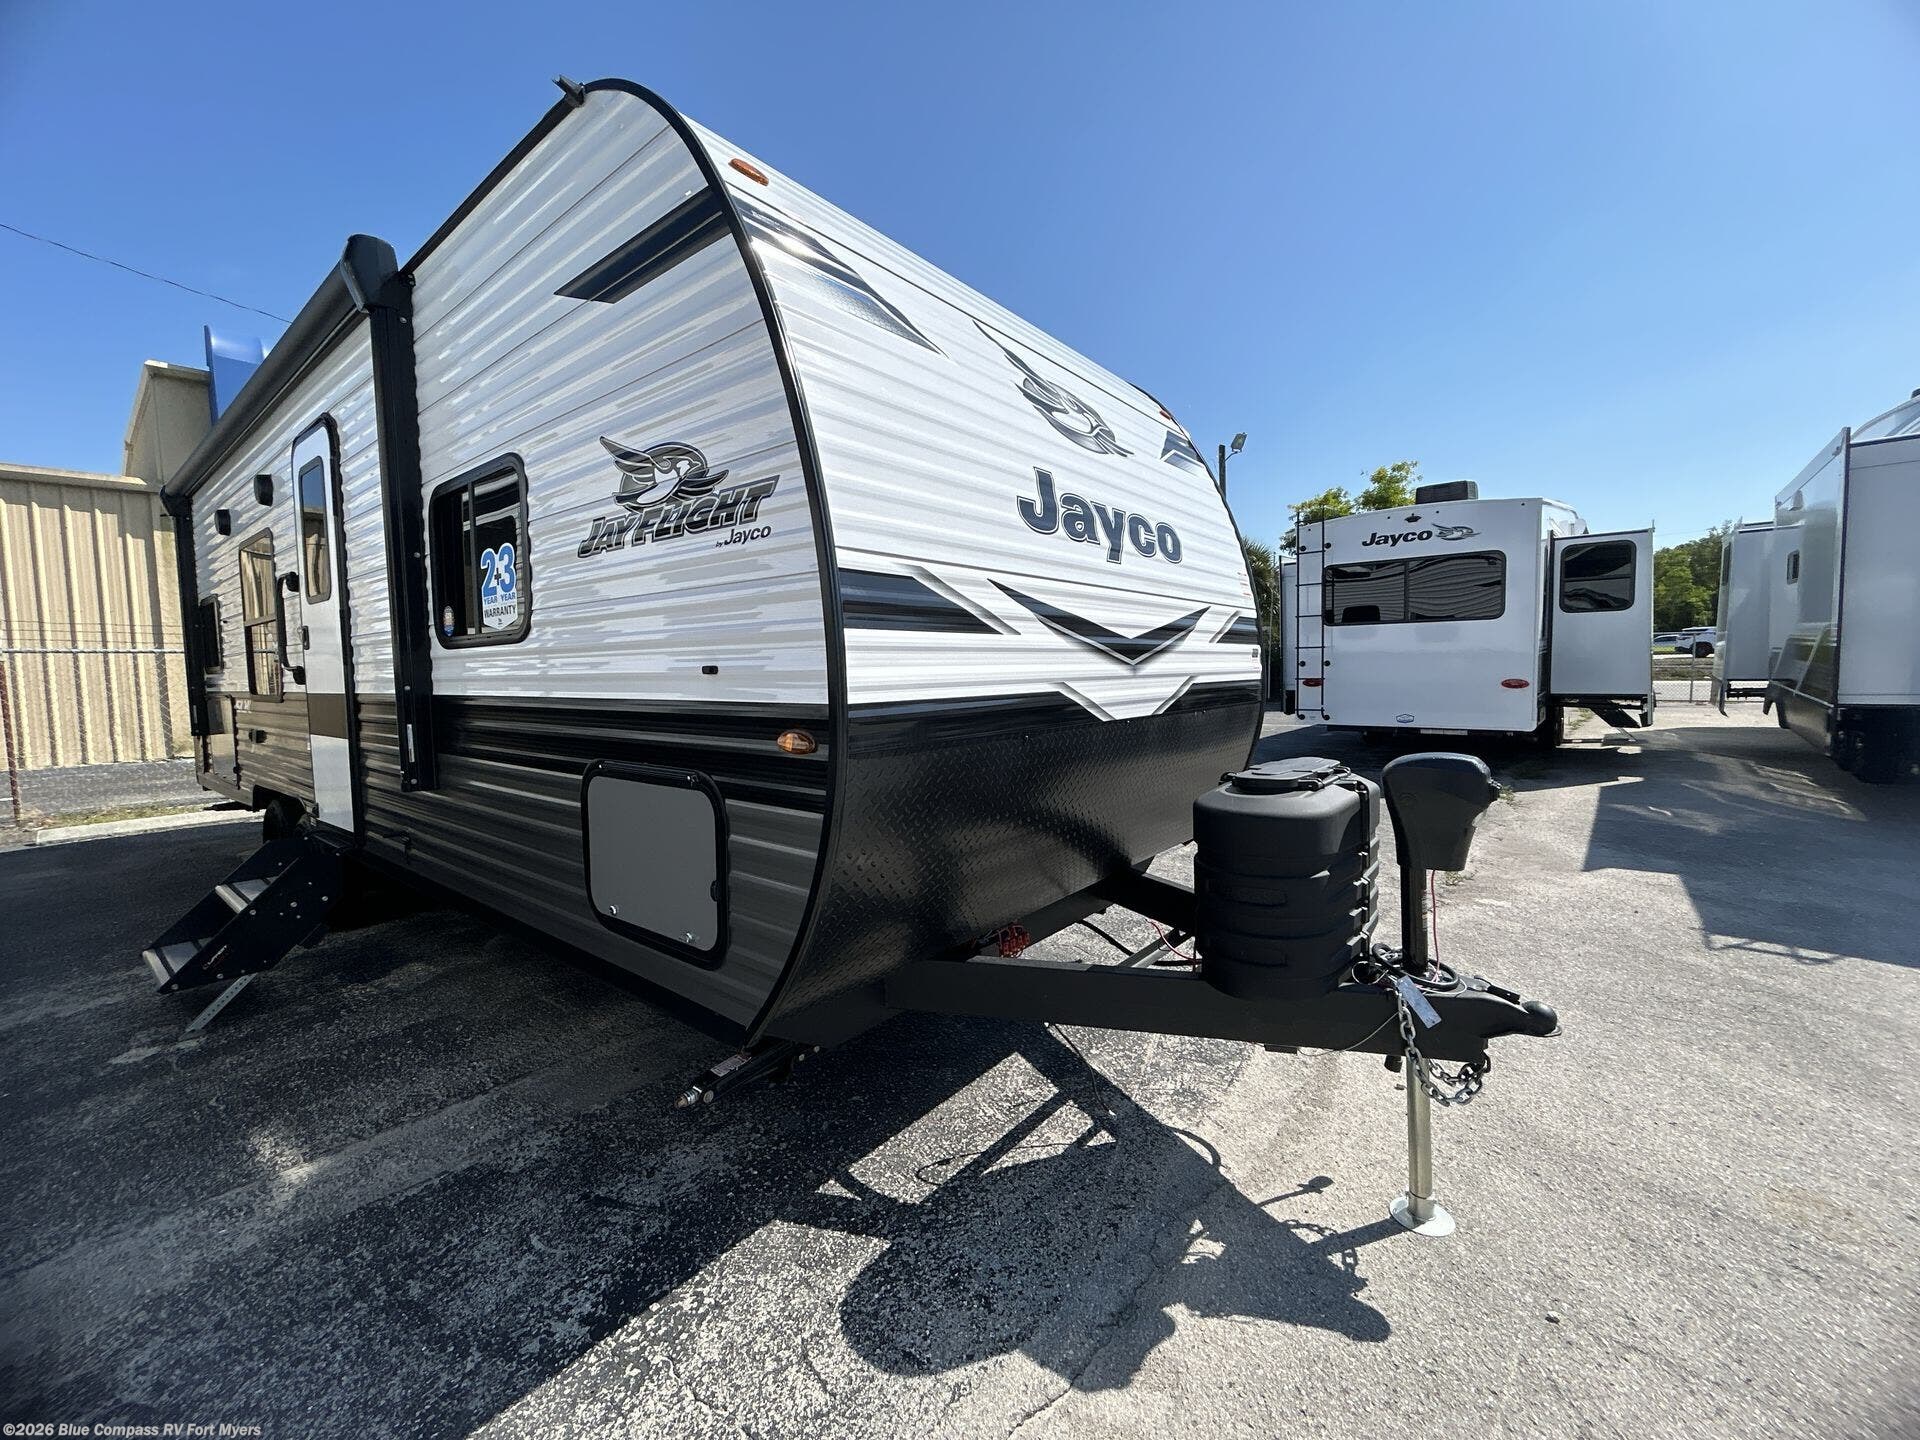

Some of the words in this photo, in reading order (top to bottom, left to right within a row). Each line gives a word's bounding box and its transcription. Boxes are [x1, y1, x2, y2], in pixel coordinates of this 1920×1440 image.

[1016, 466, 1182, 564] Jayco
[724, 525, 772, 546] Jayco
[1361, 530, 1433, 547] Jayco
[484, 596, 498, 606] YEAR
[501, 592, 516, 601] YEAR
[484, 604, 517, 618] WARRANTY
